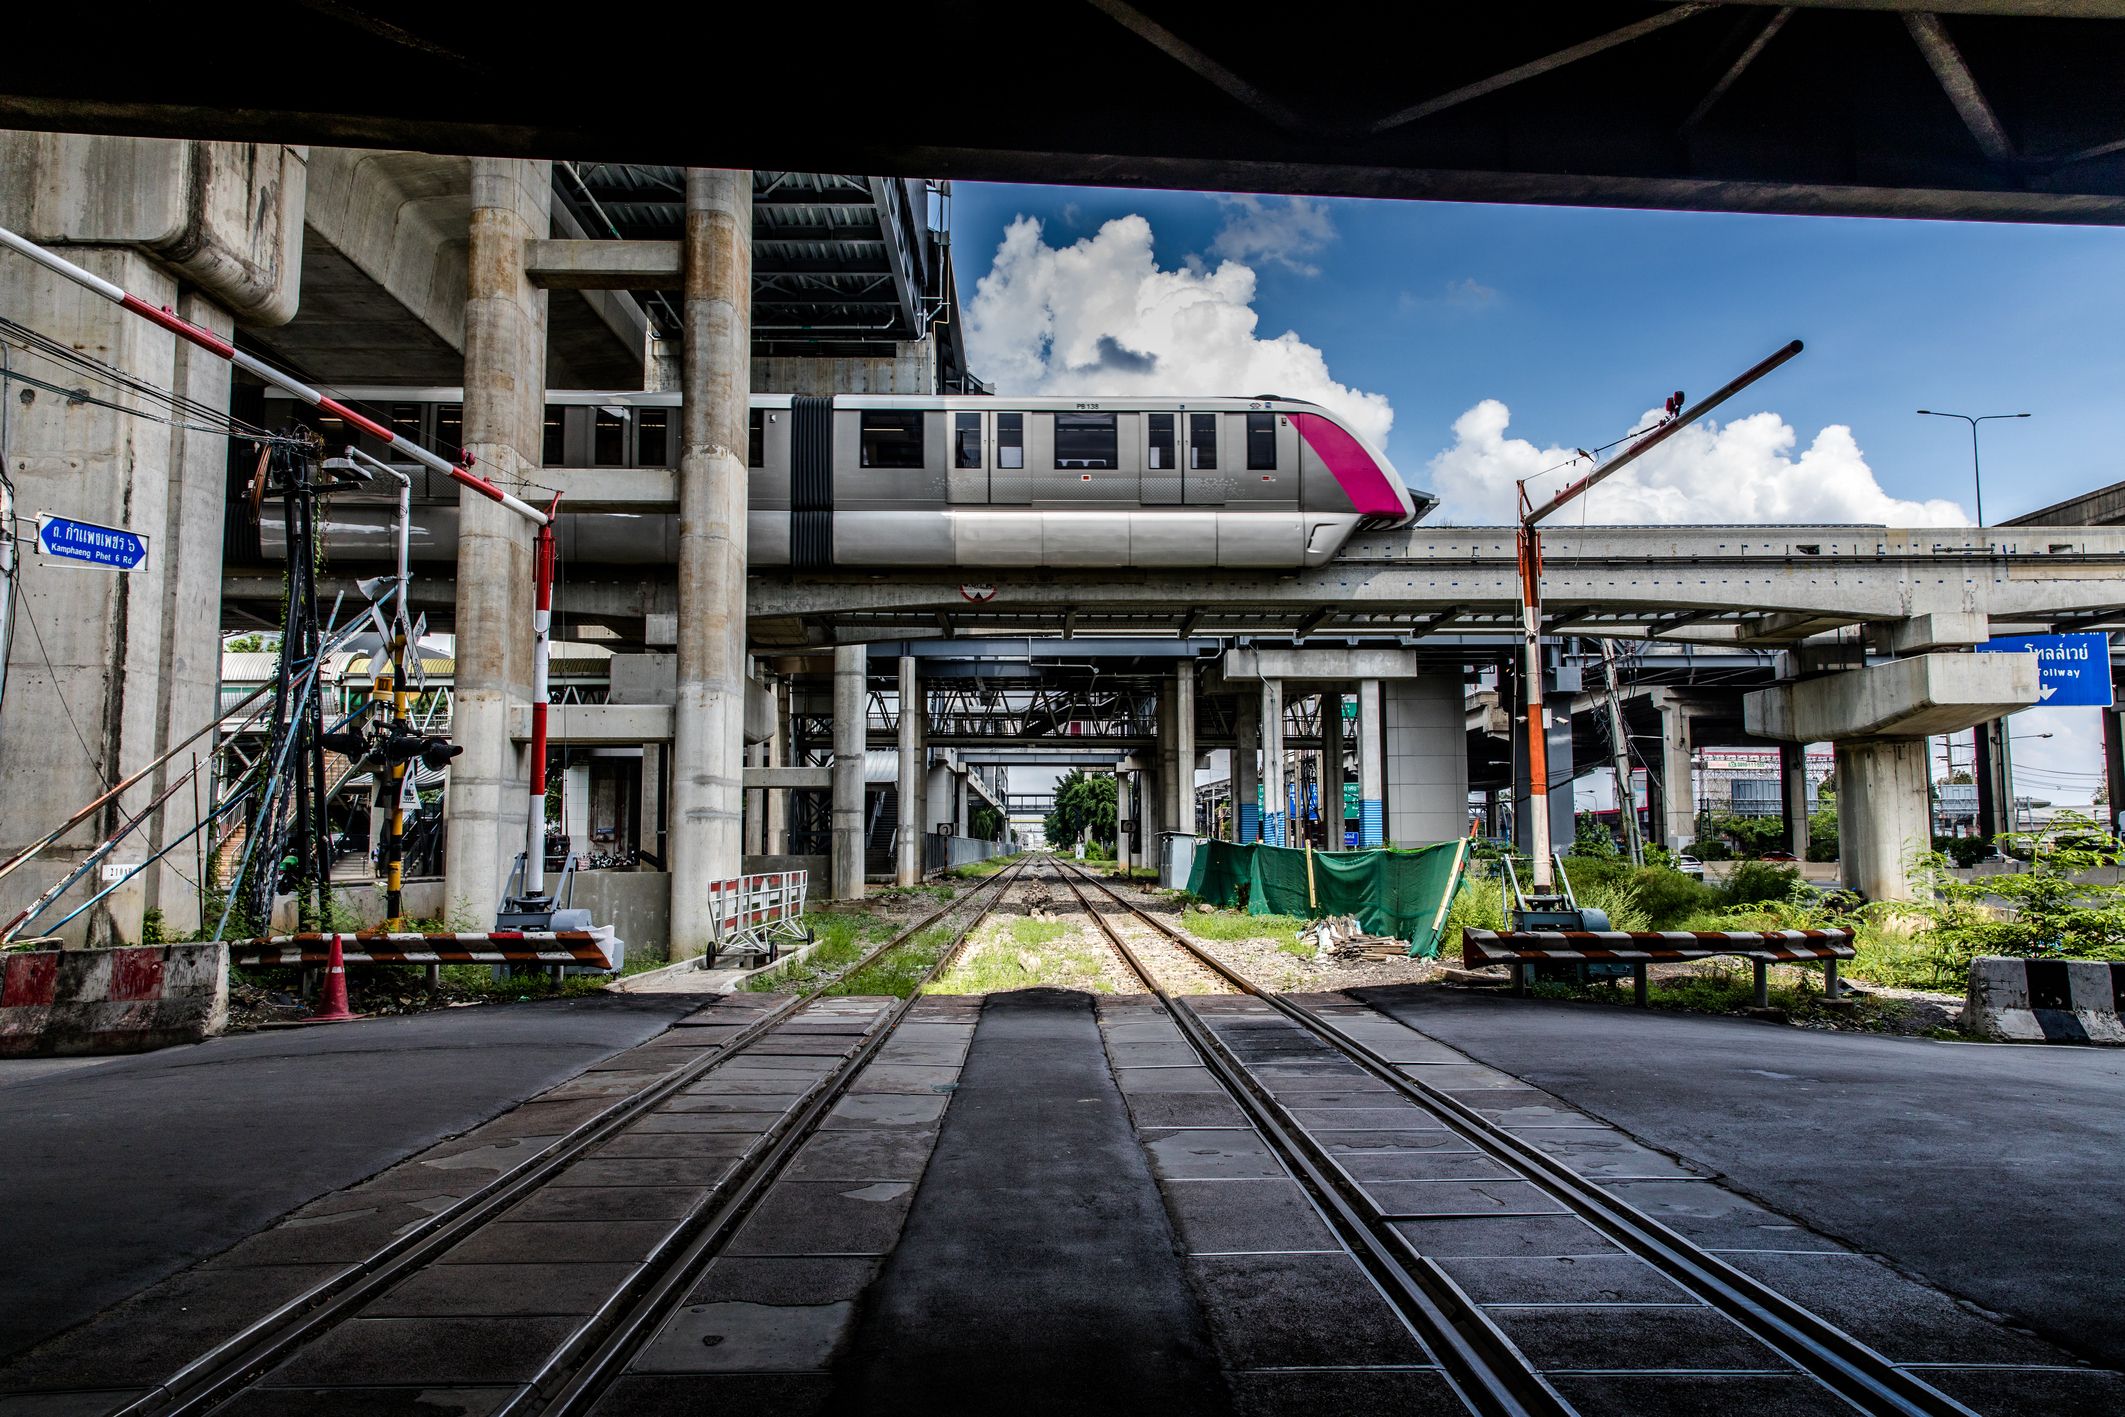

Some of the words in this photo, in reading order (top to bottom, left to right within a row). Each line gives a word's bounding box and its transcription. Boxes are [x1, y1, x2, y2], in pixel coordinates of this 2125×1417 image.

[52, 526, 62, 539] ถ.
[65, 522, 125, 551] กำแพงเพชร
[51, 542, 91, 559] Kamphaeng
[95, 550, 112, 561] Phet
[115, 554, 120, 562] 6
[122, 555, 134, 565] Rd.
[2038, 668, 2081, 679] ollway
